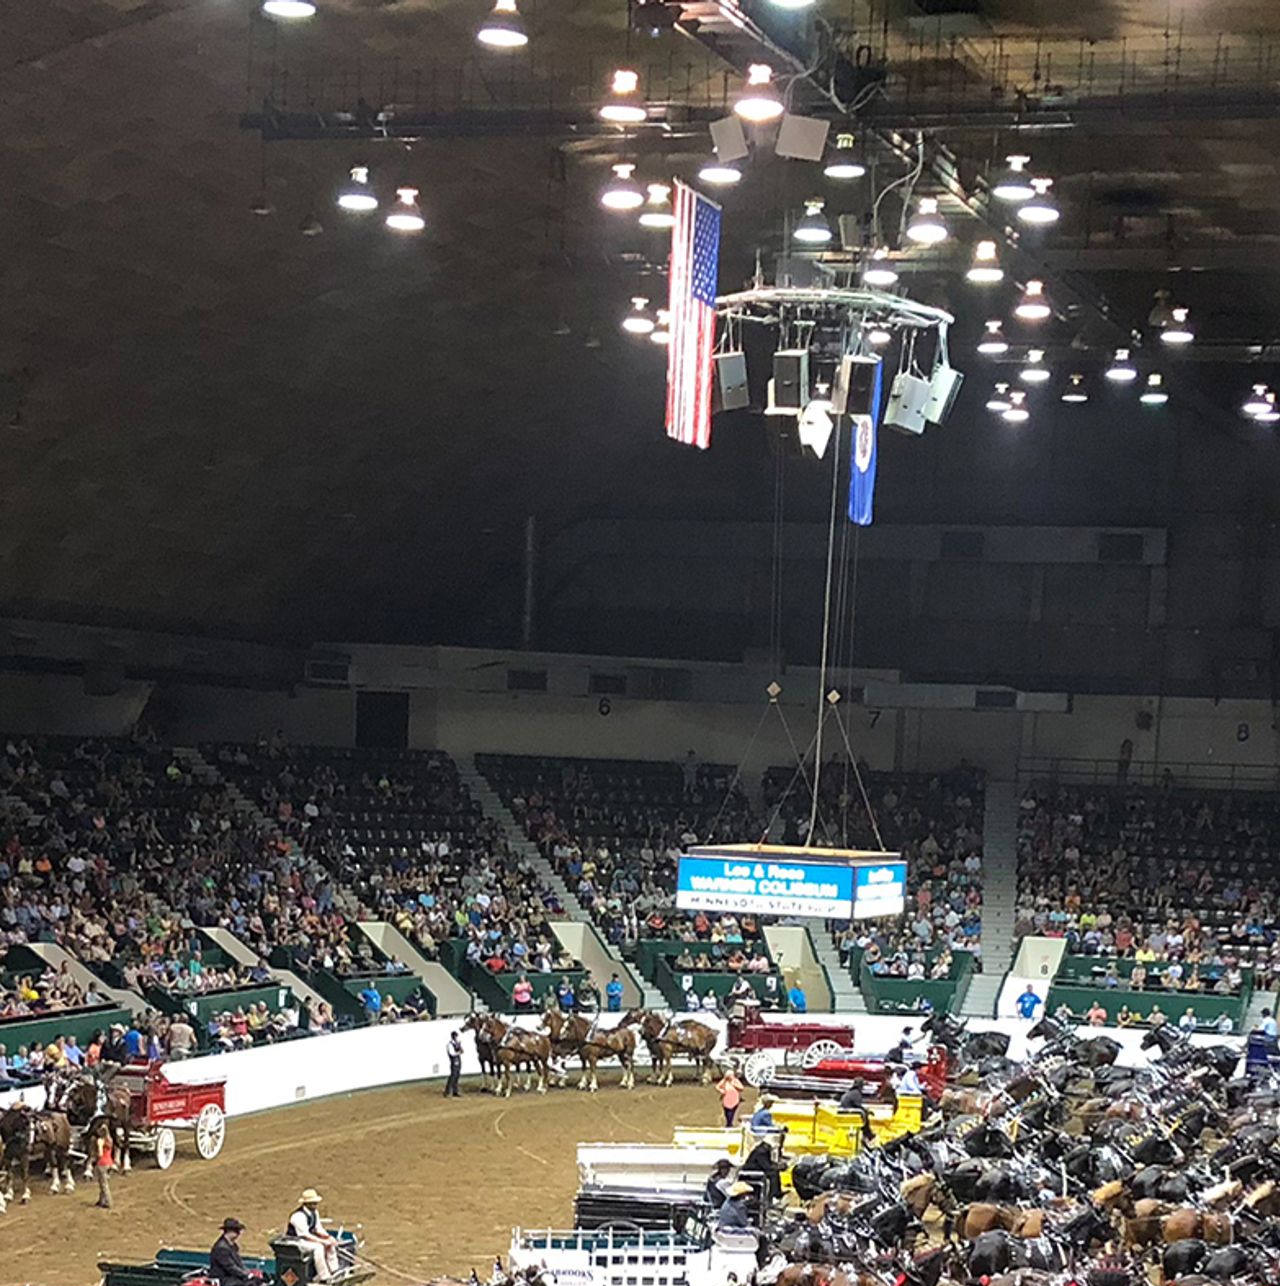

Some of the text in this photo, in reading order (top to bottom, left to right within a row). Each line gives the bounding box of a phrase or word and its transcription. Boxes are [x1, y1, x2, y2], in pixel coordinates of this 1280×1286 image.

[599, 697, 610, 715] 6
[869, 711, 881, 728] 7
[1237, 723, 1249, 741] 8
[690, 876, 756, 894] WARNER
[759, 879, 839, 898] COLISEUM
